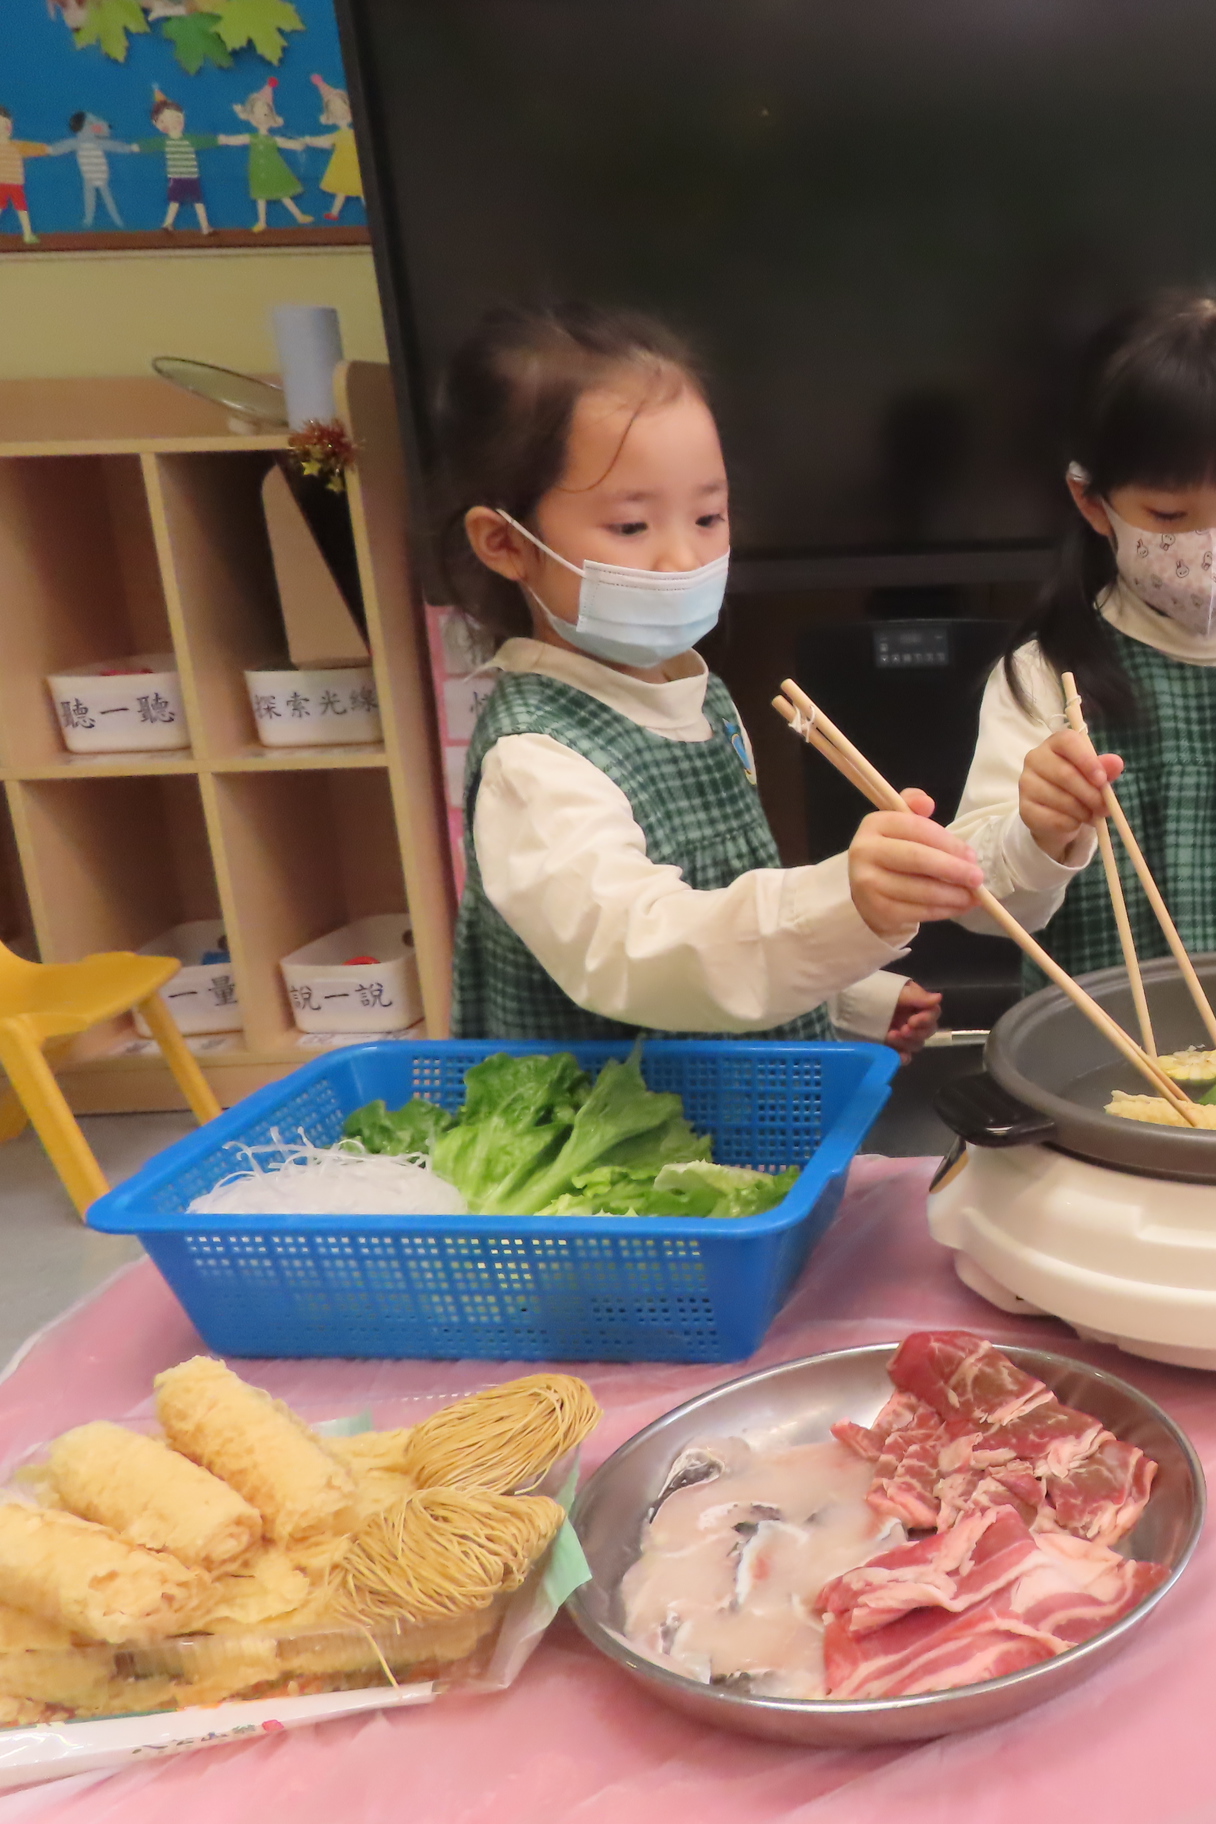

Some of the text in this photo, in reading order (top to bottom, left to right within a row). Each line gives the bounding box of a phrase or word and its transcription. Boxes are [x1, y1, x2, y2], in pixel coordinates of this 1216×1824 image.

[60, 692, 175, 730] 聽一聽
[252, 686, 378, 720] 探索光線
[290, 982, 393, 1011] 說一說
